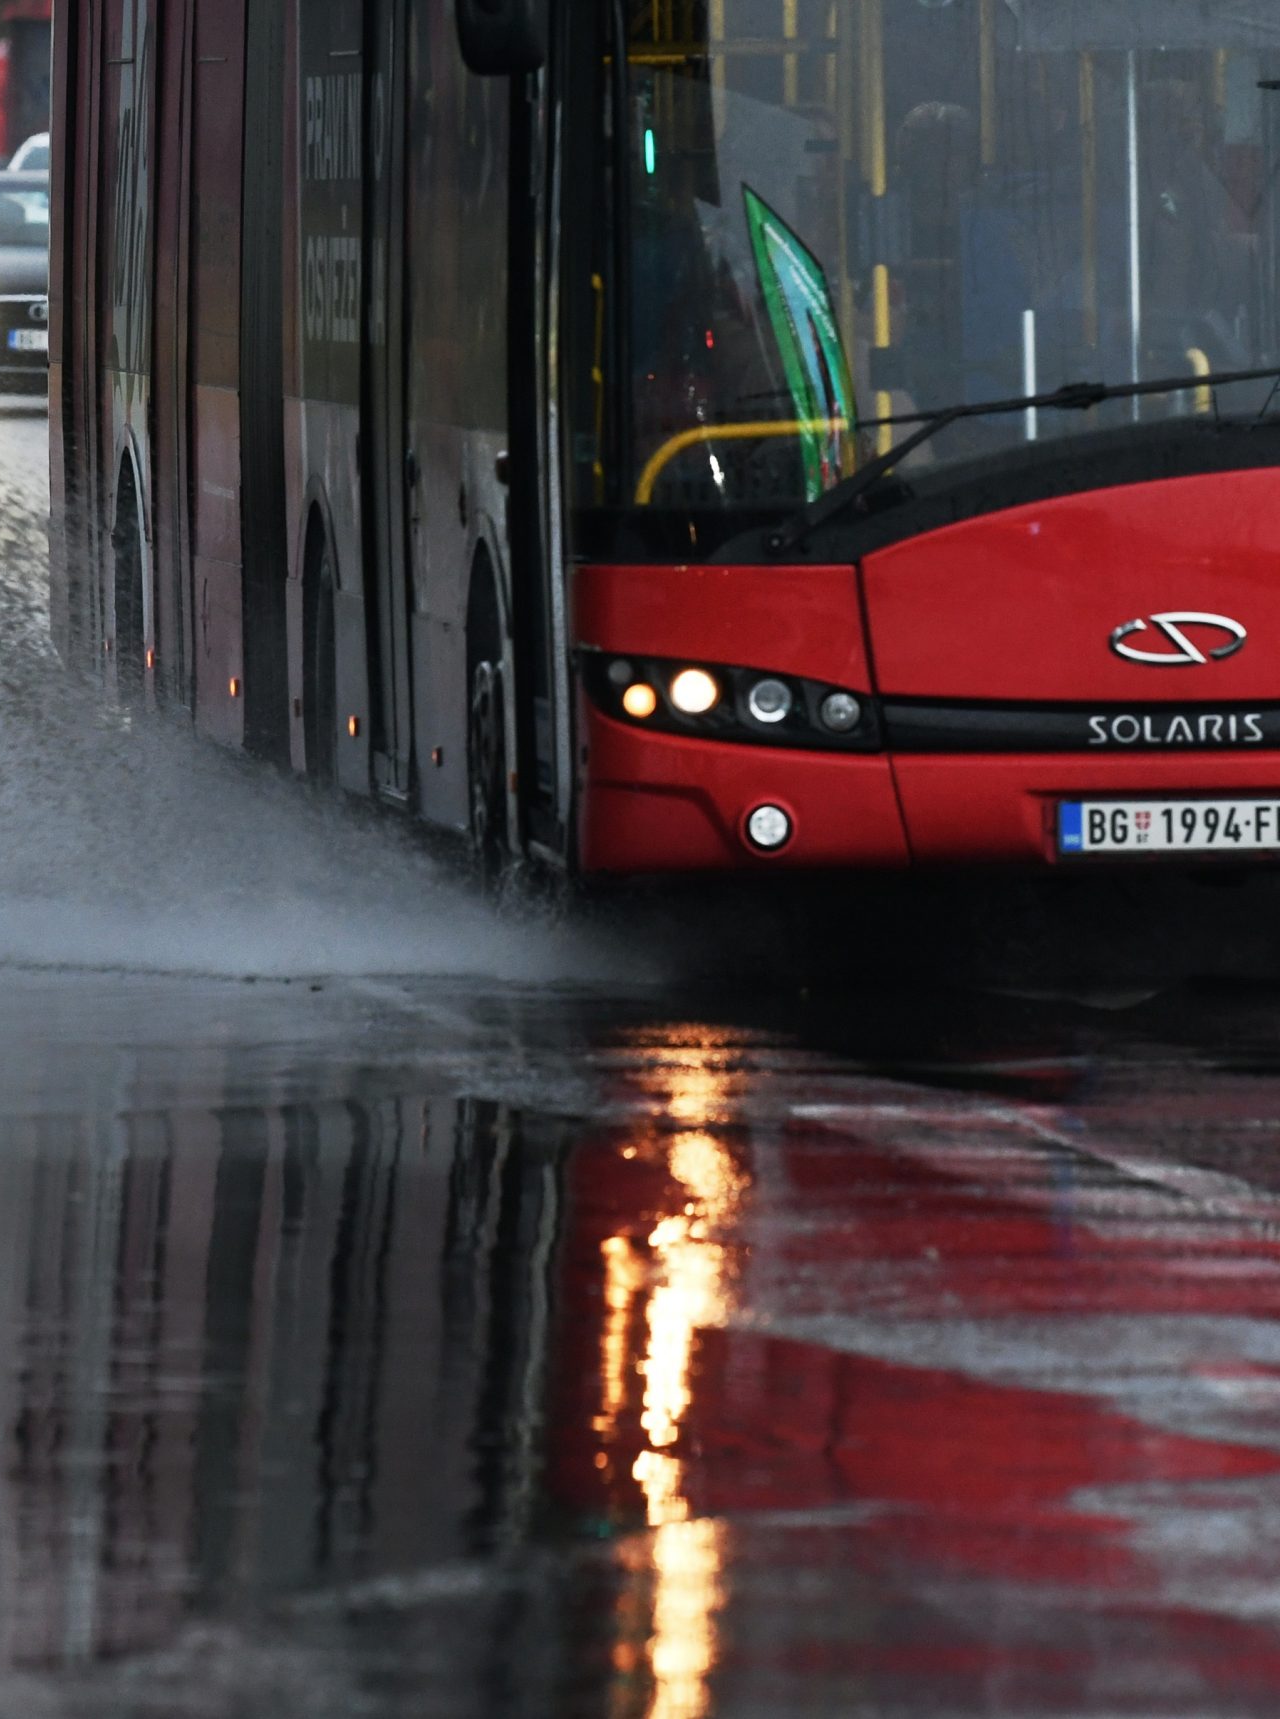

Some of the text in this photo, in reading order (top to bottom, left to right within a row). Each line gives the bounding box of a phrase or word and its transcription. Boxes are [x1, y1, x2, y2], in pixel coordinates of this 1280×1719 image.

[306, 73, 385, 181] PRAVI NIO
[1088, 713, 1264, 744] SOLARIS
[1088, 806, 1280, 845] BG 1994·F
